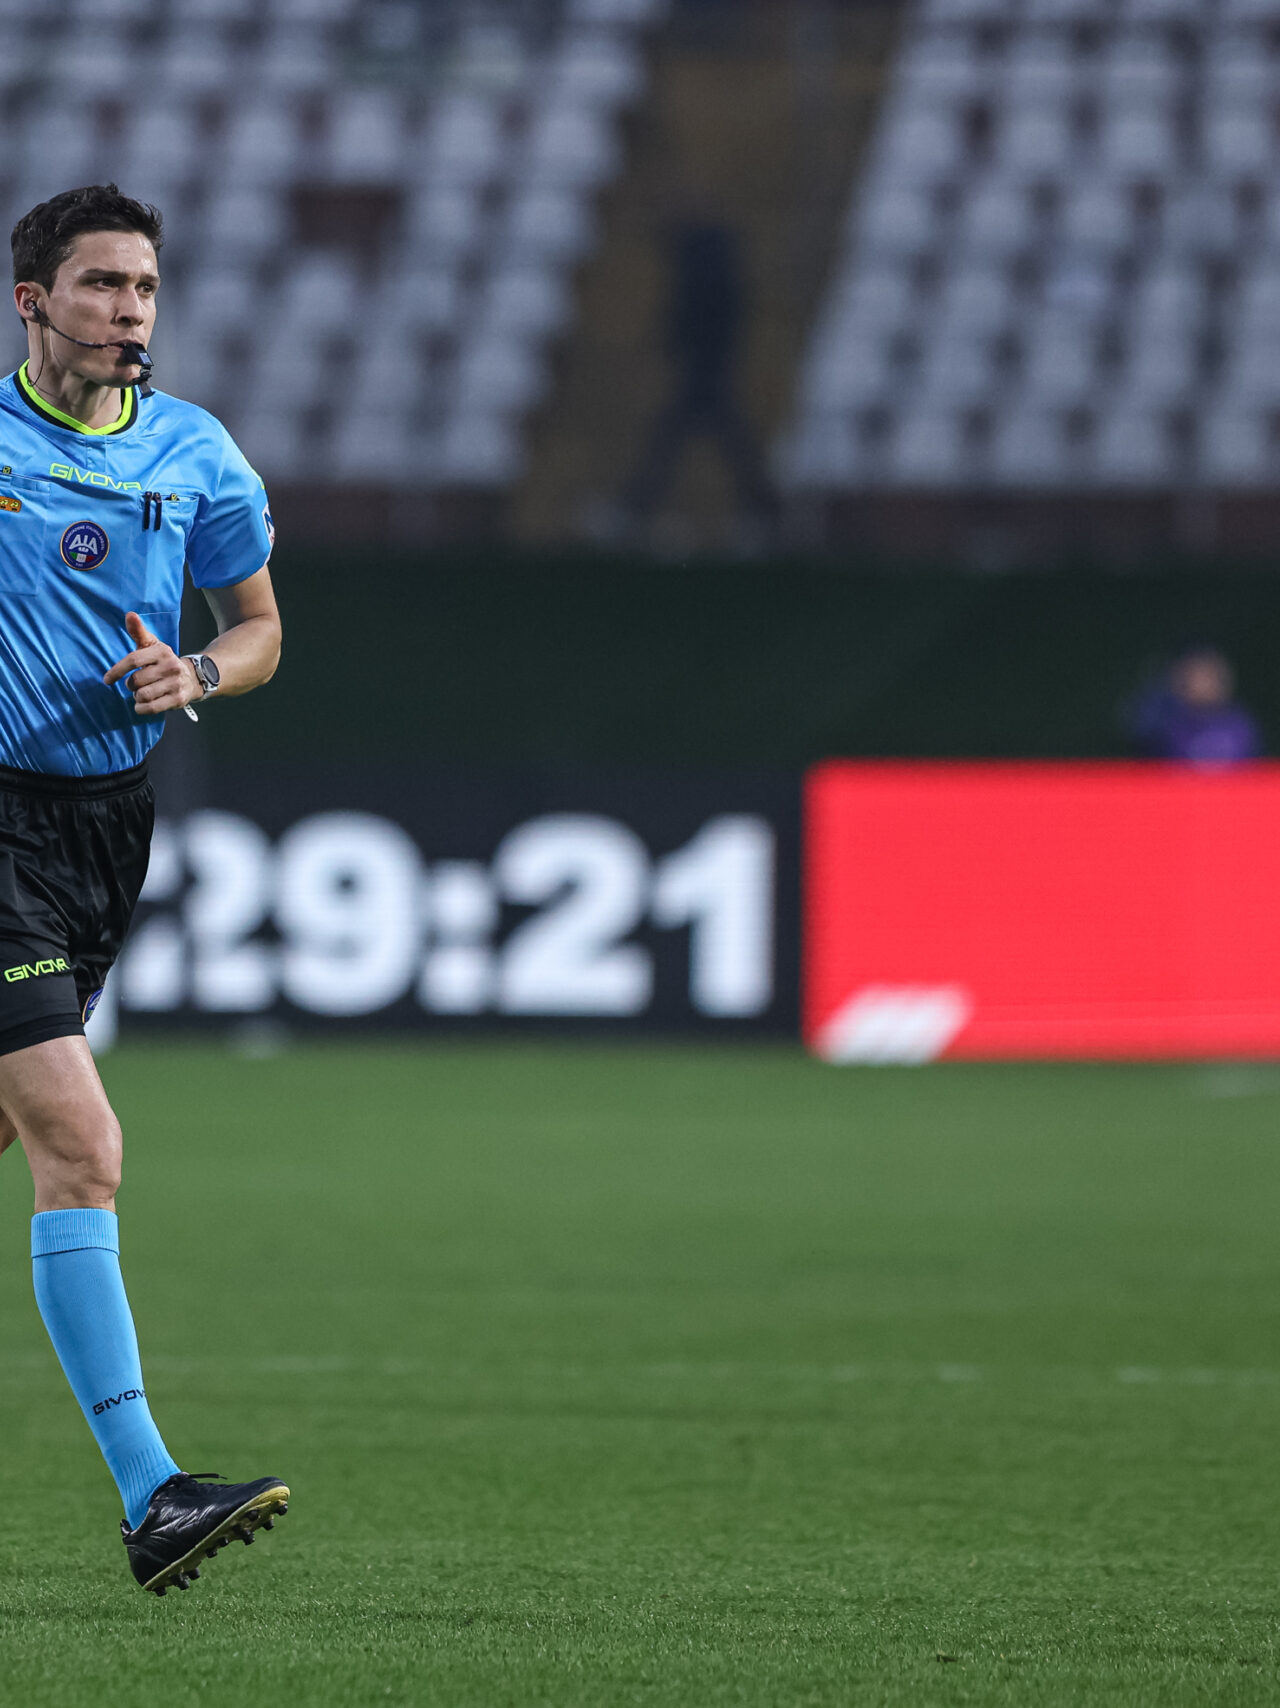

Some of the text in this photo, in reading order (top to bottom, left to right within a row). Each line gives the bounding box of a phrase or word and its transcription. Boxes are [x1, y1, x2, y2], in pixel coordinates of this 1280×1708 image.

[49, 462, 143, 491] GIVOVA
[68, 534, 98, 555] AIA
[121, 810, 774, 1016] 29:21
